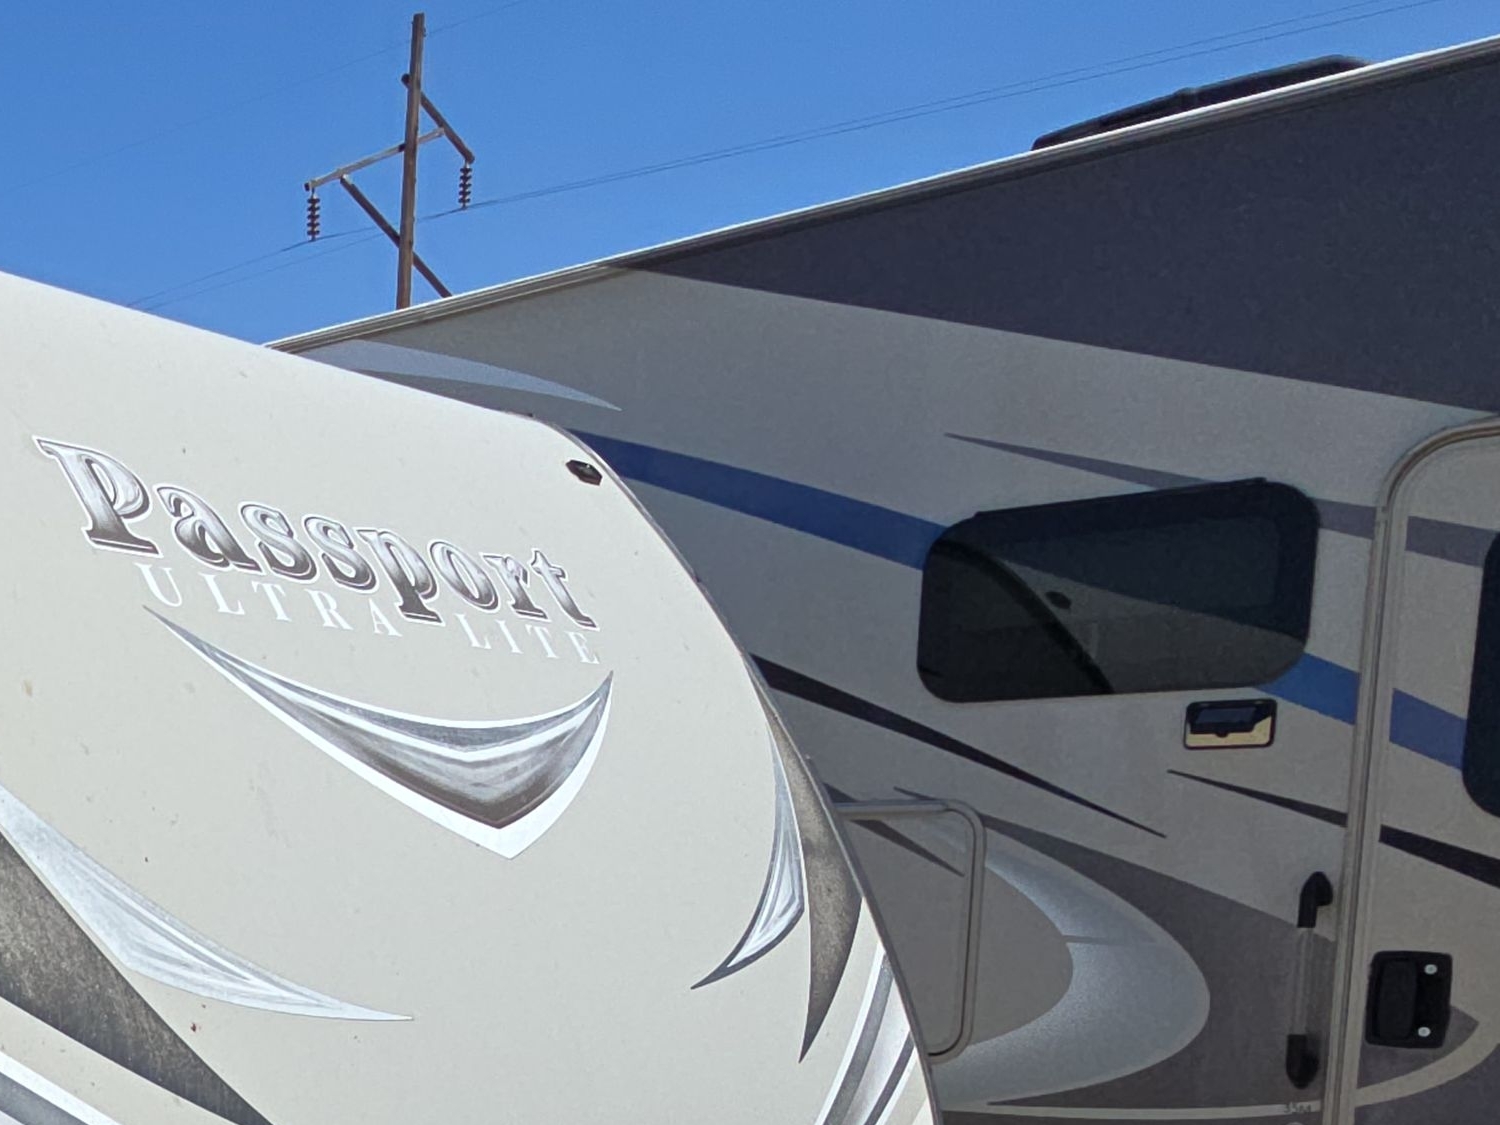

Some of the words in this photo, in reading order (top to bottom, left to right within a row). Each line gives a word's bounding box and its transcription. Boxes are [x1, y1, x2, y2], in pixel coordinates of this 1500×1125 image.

[32, 436, 600, 630] Passport
[135, 563, 402, 637] ULTRA
[456, 613, 600, 664] LITE
